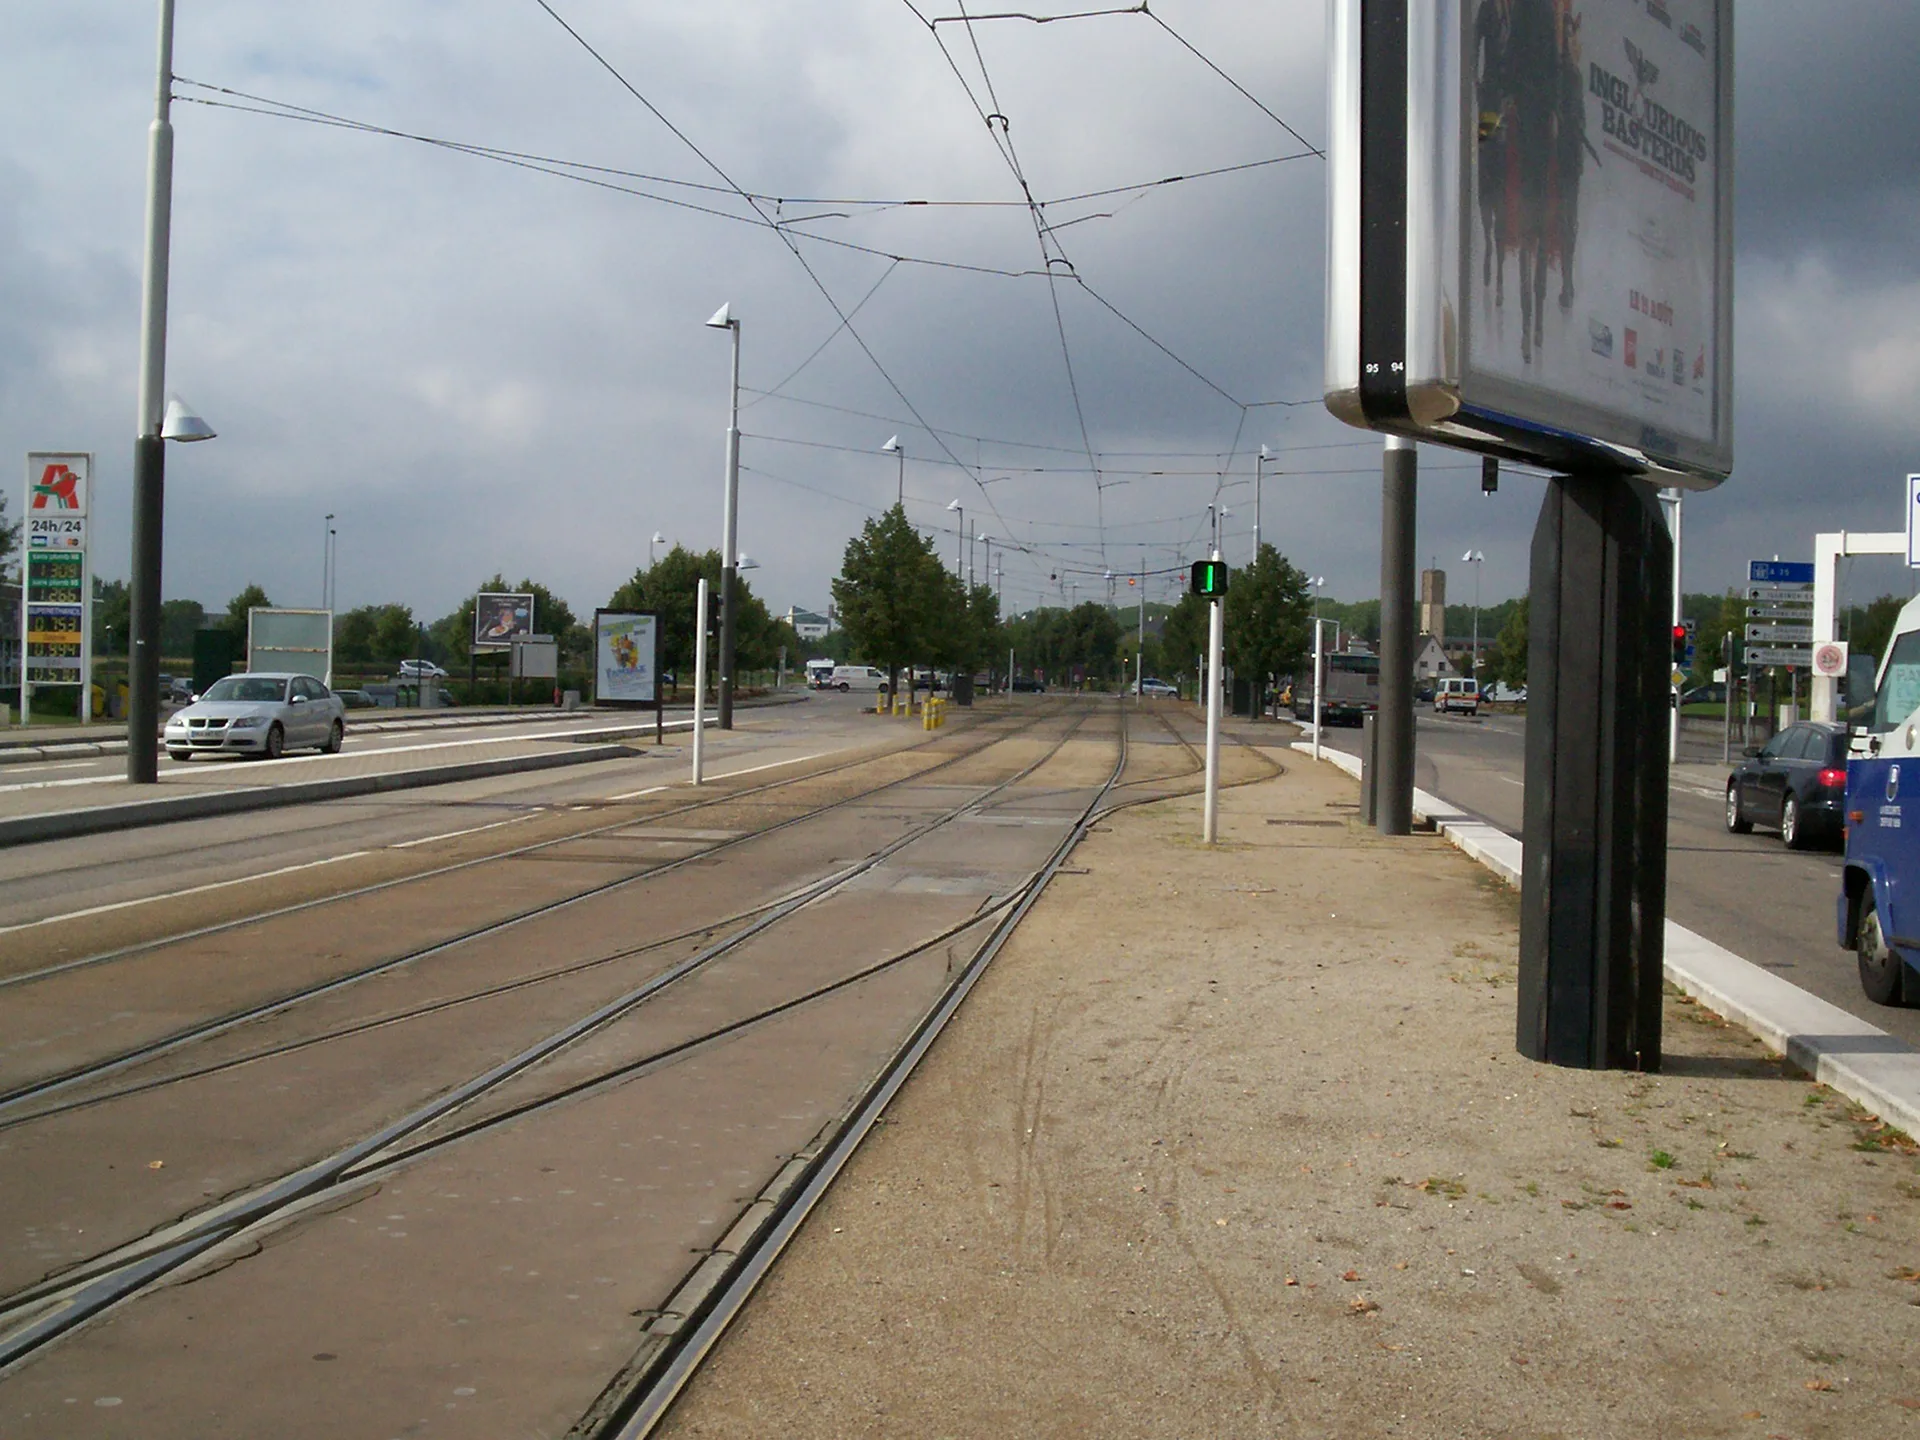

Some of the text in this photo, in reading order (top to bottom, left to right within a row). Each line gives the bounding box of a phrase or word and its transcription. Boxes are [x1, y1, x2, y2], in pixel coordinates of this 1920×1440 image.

[1602, 101, 1696, 185] BASTERDS
[1366, 363, 1379, 373] 95
[31, 519, 81, 533] 24h/24
